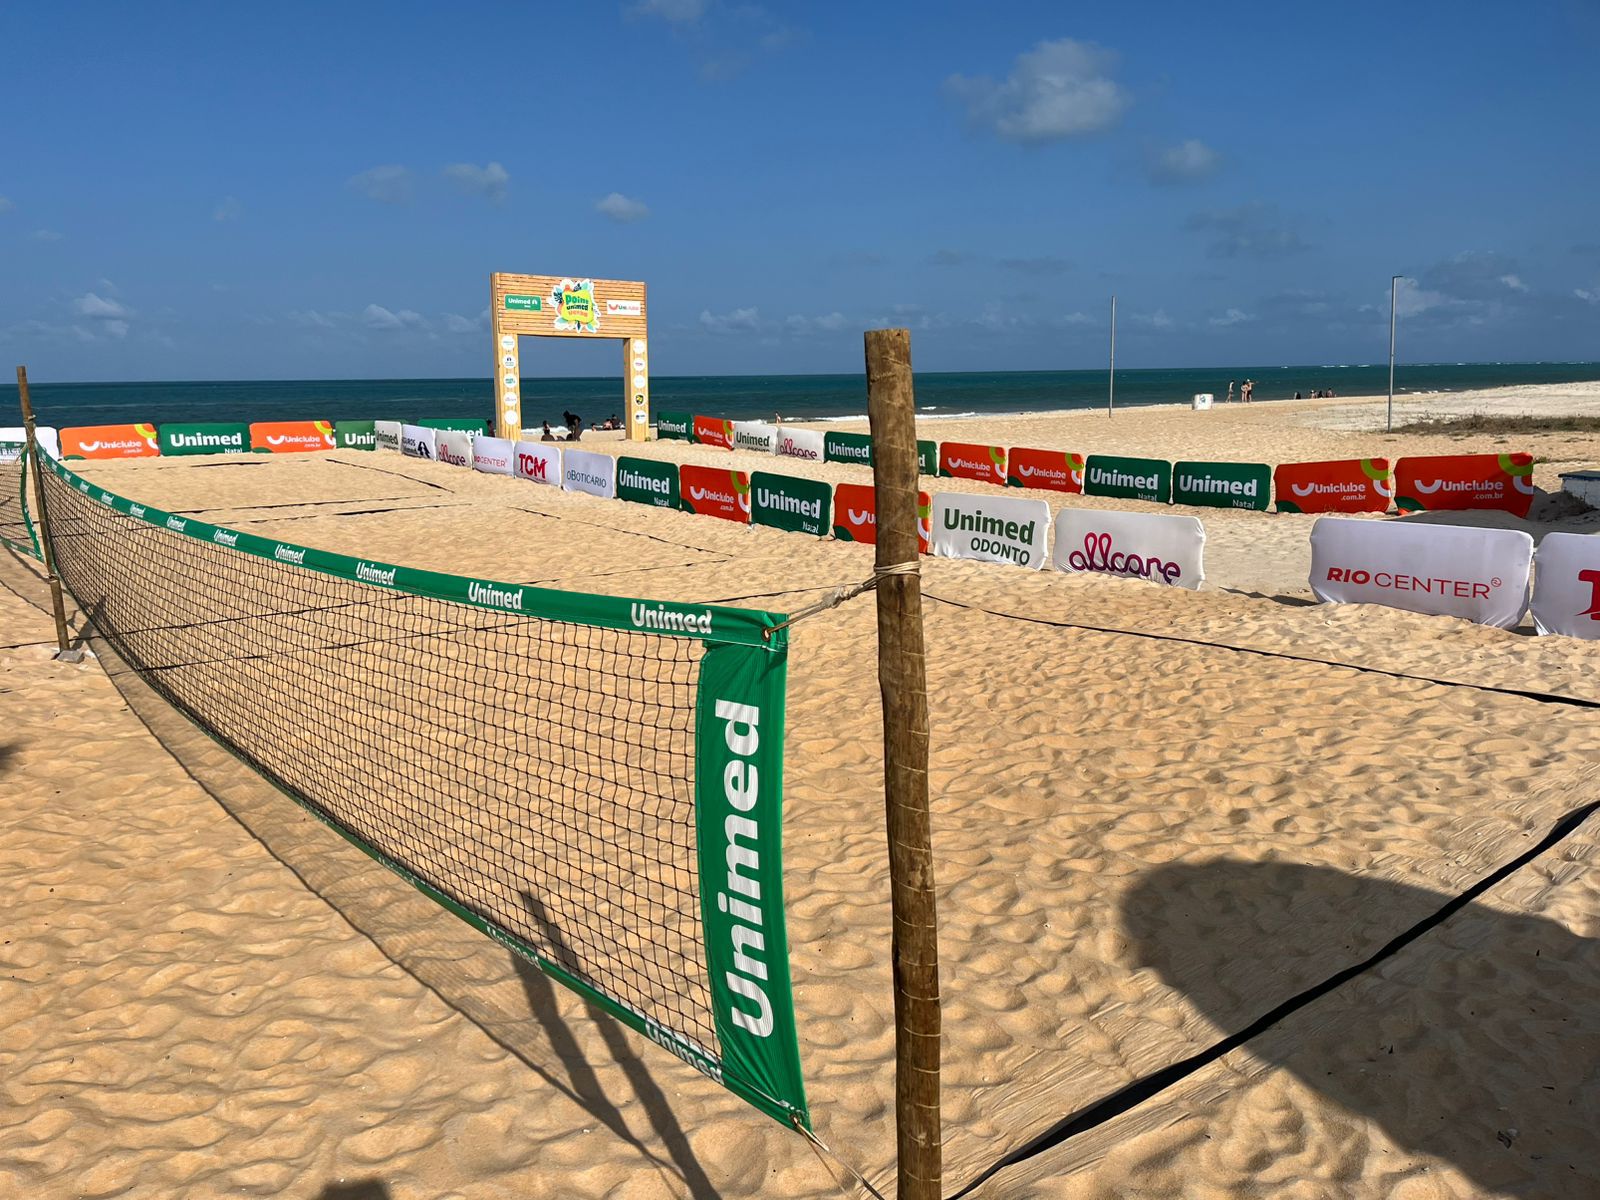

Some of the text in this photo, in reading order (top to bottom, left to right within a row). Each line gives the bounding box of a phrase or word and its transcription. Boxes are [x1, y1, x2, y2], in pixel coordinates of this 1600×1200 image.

[658, 420, 687, 433] Unimed
[100, 440, 142, 449] Uniclube
[170, 432, 242, 447] Unimed
[284, 435, 321, 443] Uniclube
[345, 432, 376, 445] Uni
[735, 431, 770, 447] Unimed
[829, 442, 870, 458] Unimed
[518, 453, 548, 479] TCM
[960, 460, 991, 471] Uniclube
[1033, 467, 1067, 479] Uniclube
[619, 469, 670, 494] Unimed
[1090, 467, 1159, 490] Unimed
[1179, 474, 1257, 497] Unimed
[1442, 479, 1504, 492] Uniclube
[1314, 482, 1366, 494] Uniclube
[653, 497, 670, 507] Natal
[704, 490, 735, 503] Uniclube
[757, 487, 821, 519] Unimed
[1137, 492, 1157, 502] Natal
[1232, 498, 1255, 509] Natal
[1341, 493, 1366, 501] .com.br
[802, 520, 819, 534] Natal
[943, 507, 1036, 546] Unimed
[213, 528, 239, 547] Unimed
[274, 544, 306, 565] Unimed
[970, 536, 1031, 566] ODONTO
[1069, 532, 1181, 584] allcare
[355, 562, 397, 586] Unimed
[468, 582, 523, 610] Unimed
[631, 602, 713, 634] Unimed
[714, 697, 775, 1038] Unimed
[645, 1019, 725, 1086] Unimed
